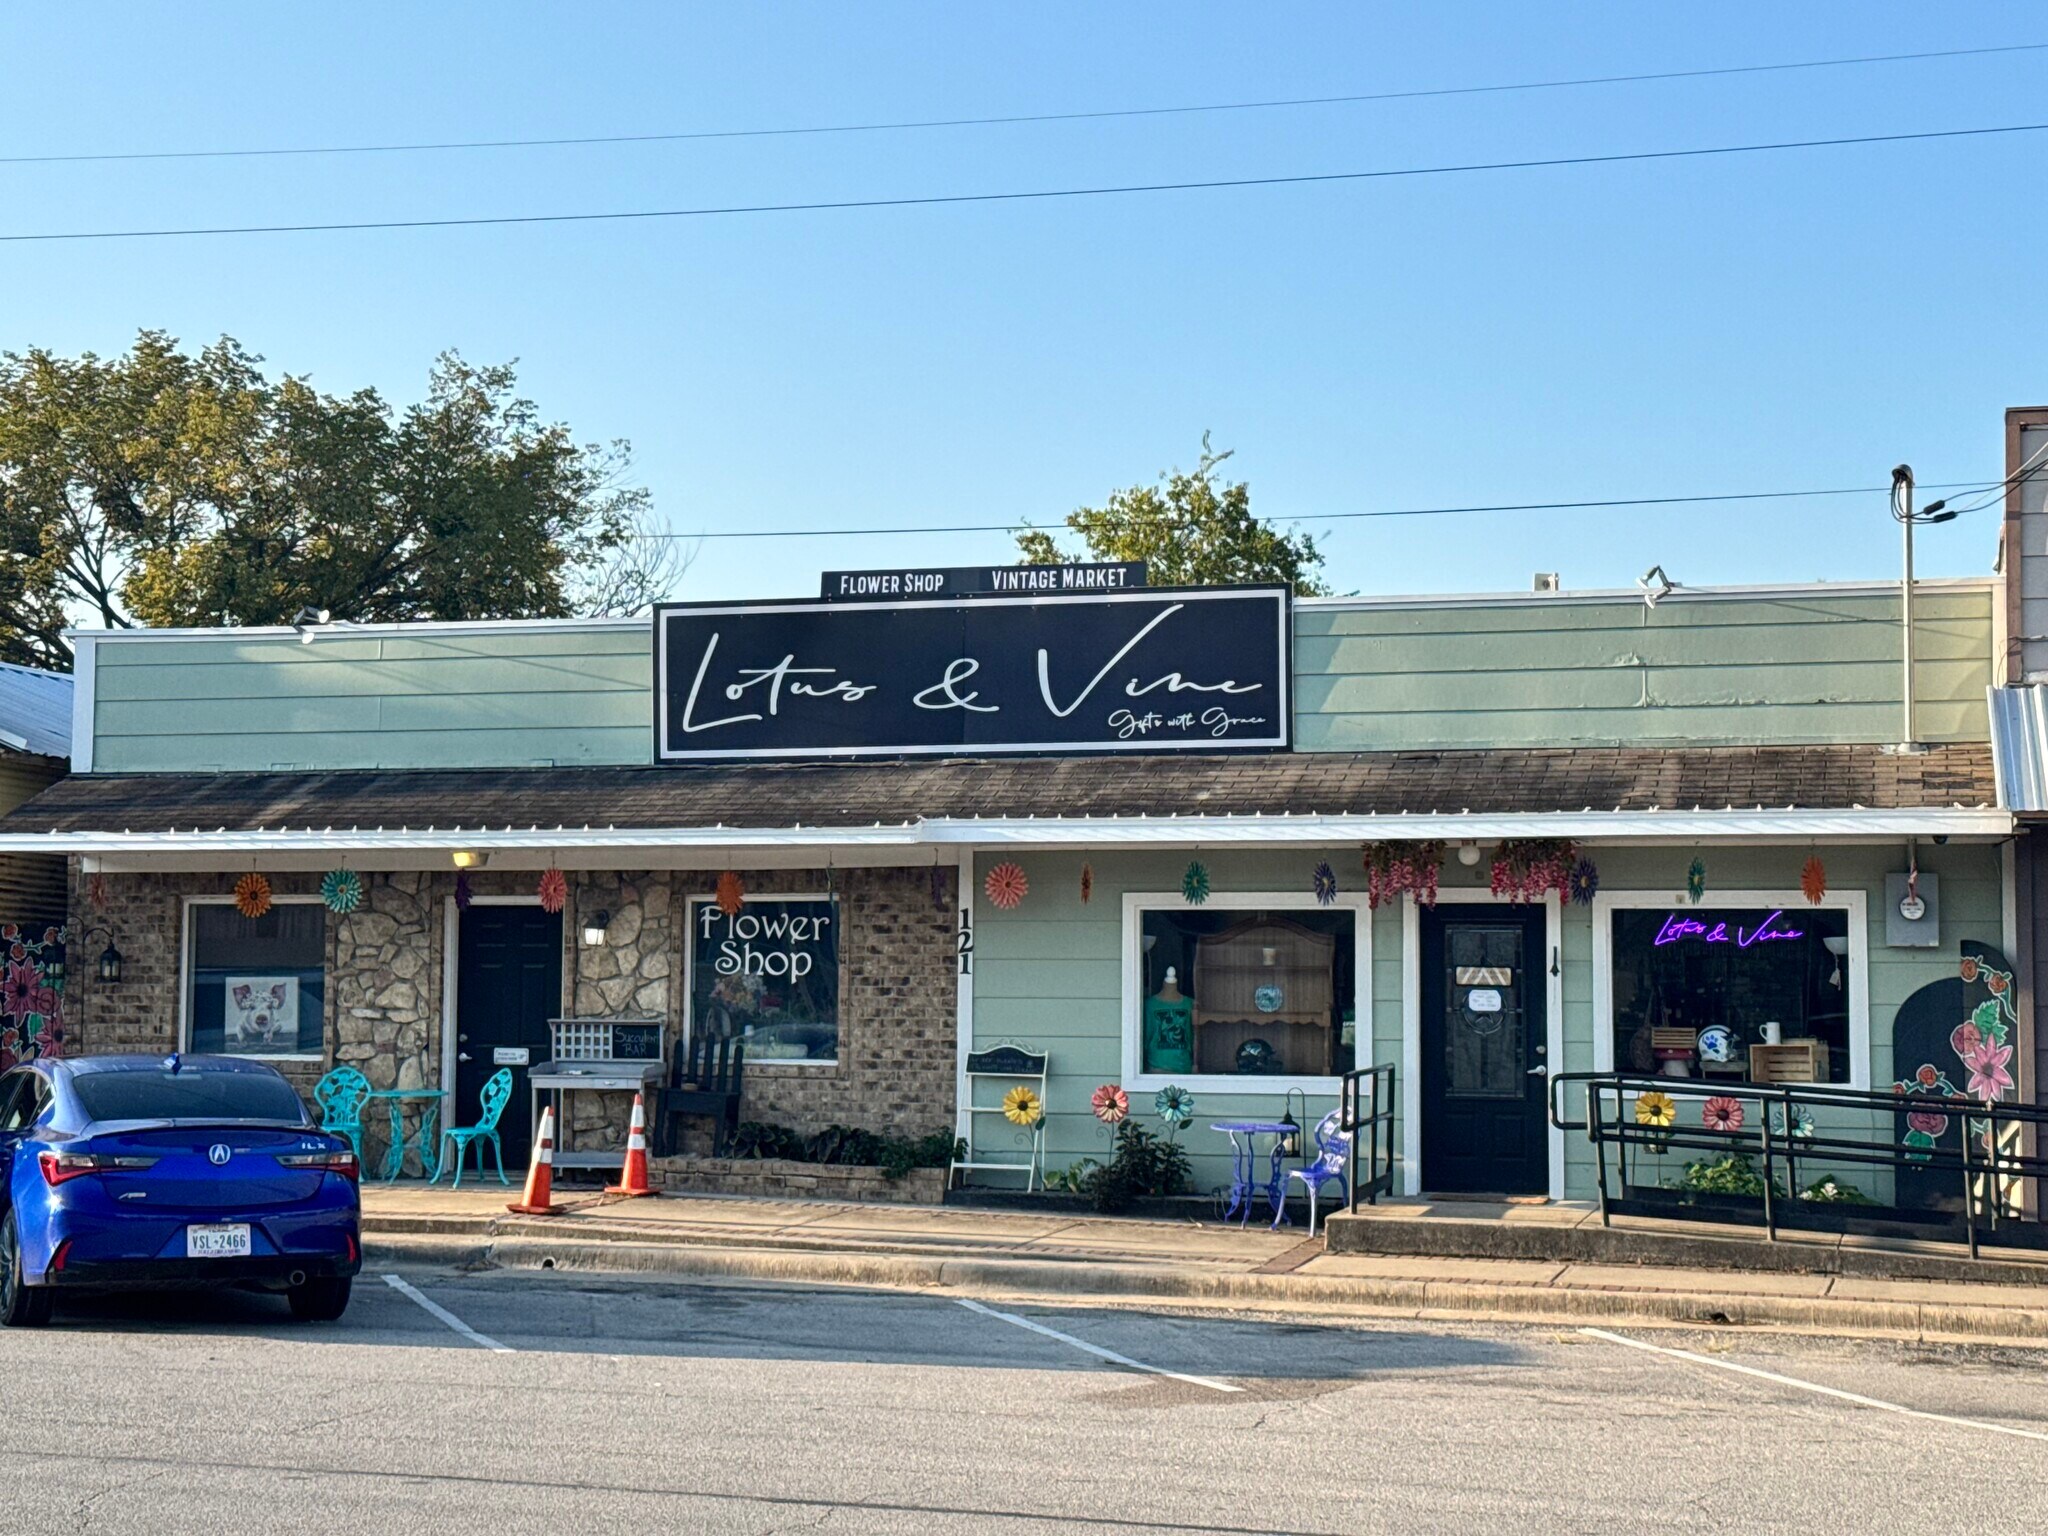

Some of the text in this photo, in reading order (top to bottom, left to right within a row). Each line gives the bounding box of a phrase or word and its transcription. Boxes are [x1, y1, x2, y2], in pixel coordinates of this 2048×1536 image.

[840, 568, 1127, 595] FLOWER SHOP VINTAGE MARKET
[683, 603, 1263, 733] Lotus & Vine
[1167, 712, 1196, 731] with
[1201, 707, 1266, 737] Grace
[700, 905, 830, 945] Flower
[957, 907, 975, 975] 121
[1654, 910, 1803, 947] Lotus & Vine
[715, 940, 812, 985] Shop
[621, 1042, 648, 1057] BAR
